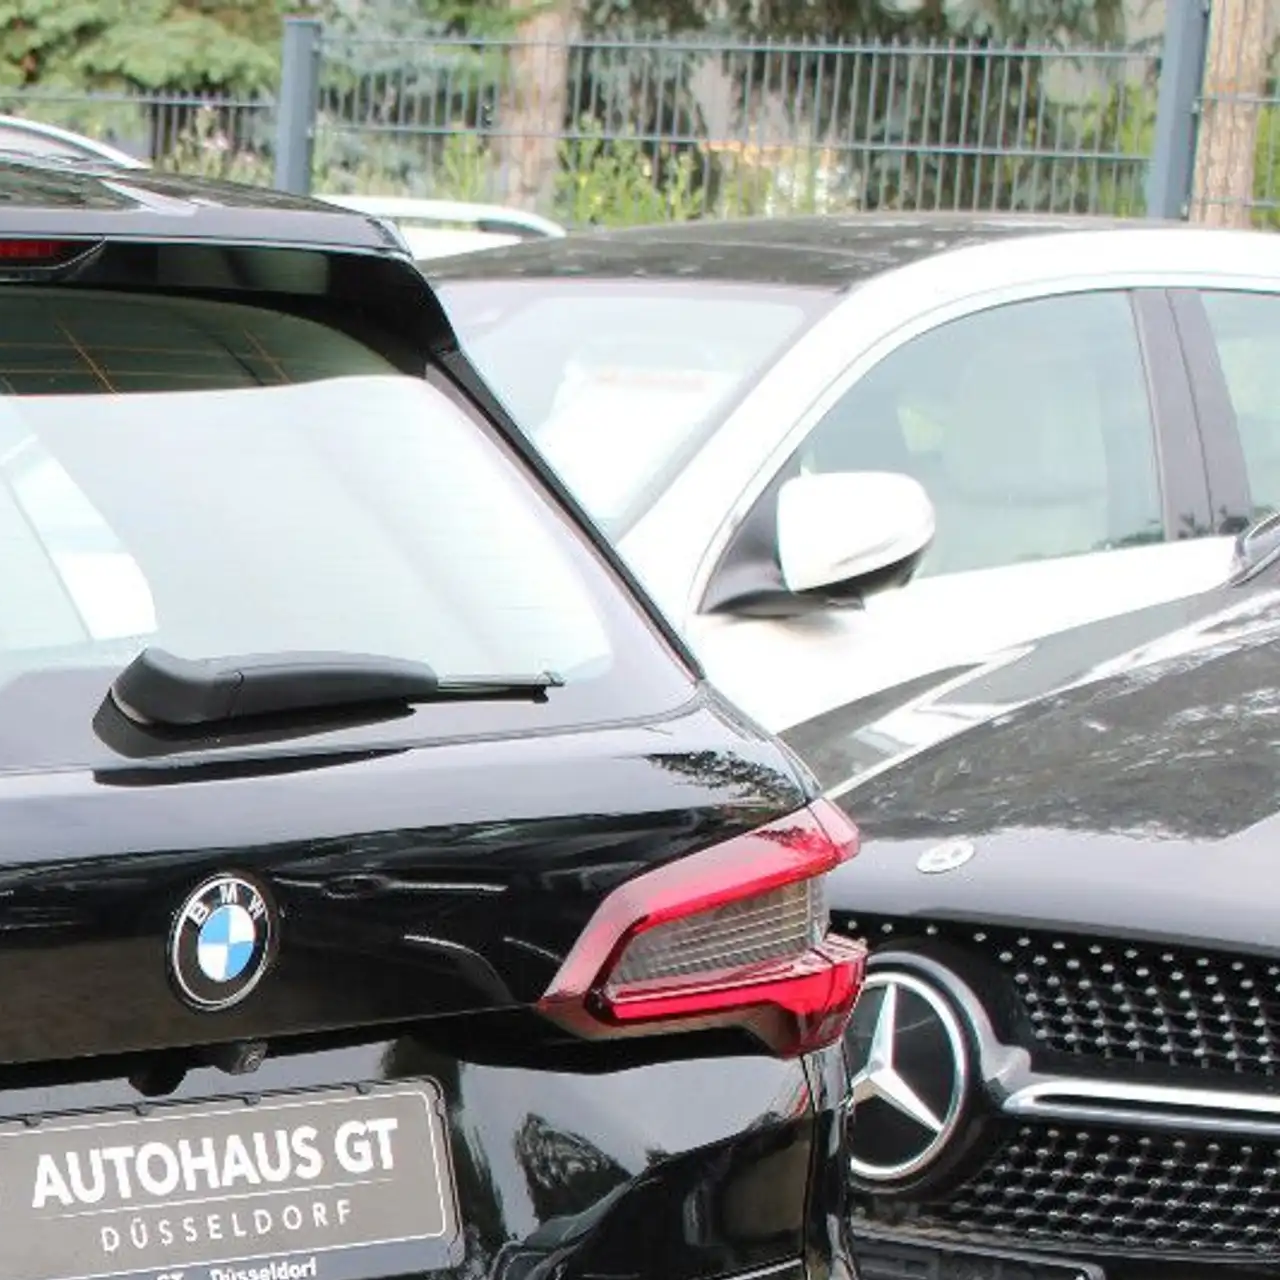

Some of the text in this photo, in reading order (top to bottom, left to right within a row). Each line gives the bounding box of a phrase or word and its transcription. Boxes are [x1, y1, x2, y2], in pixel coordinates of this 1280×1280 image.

[183, 882, 266, 927] BMW
[32, 1118, 399, 1209] AUTOHAUS GT
[101, 1200, 352, 1251] DÜSSELDORF
